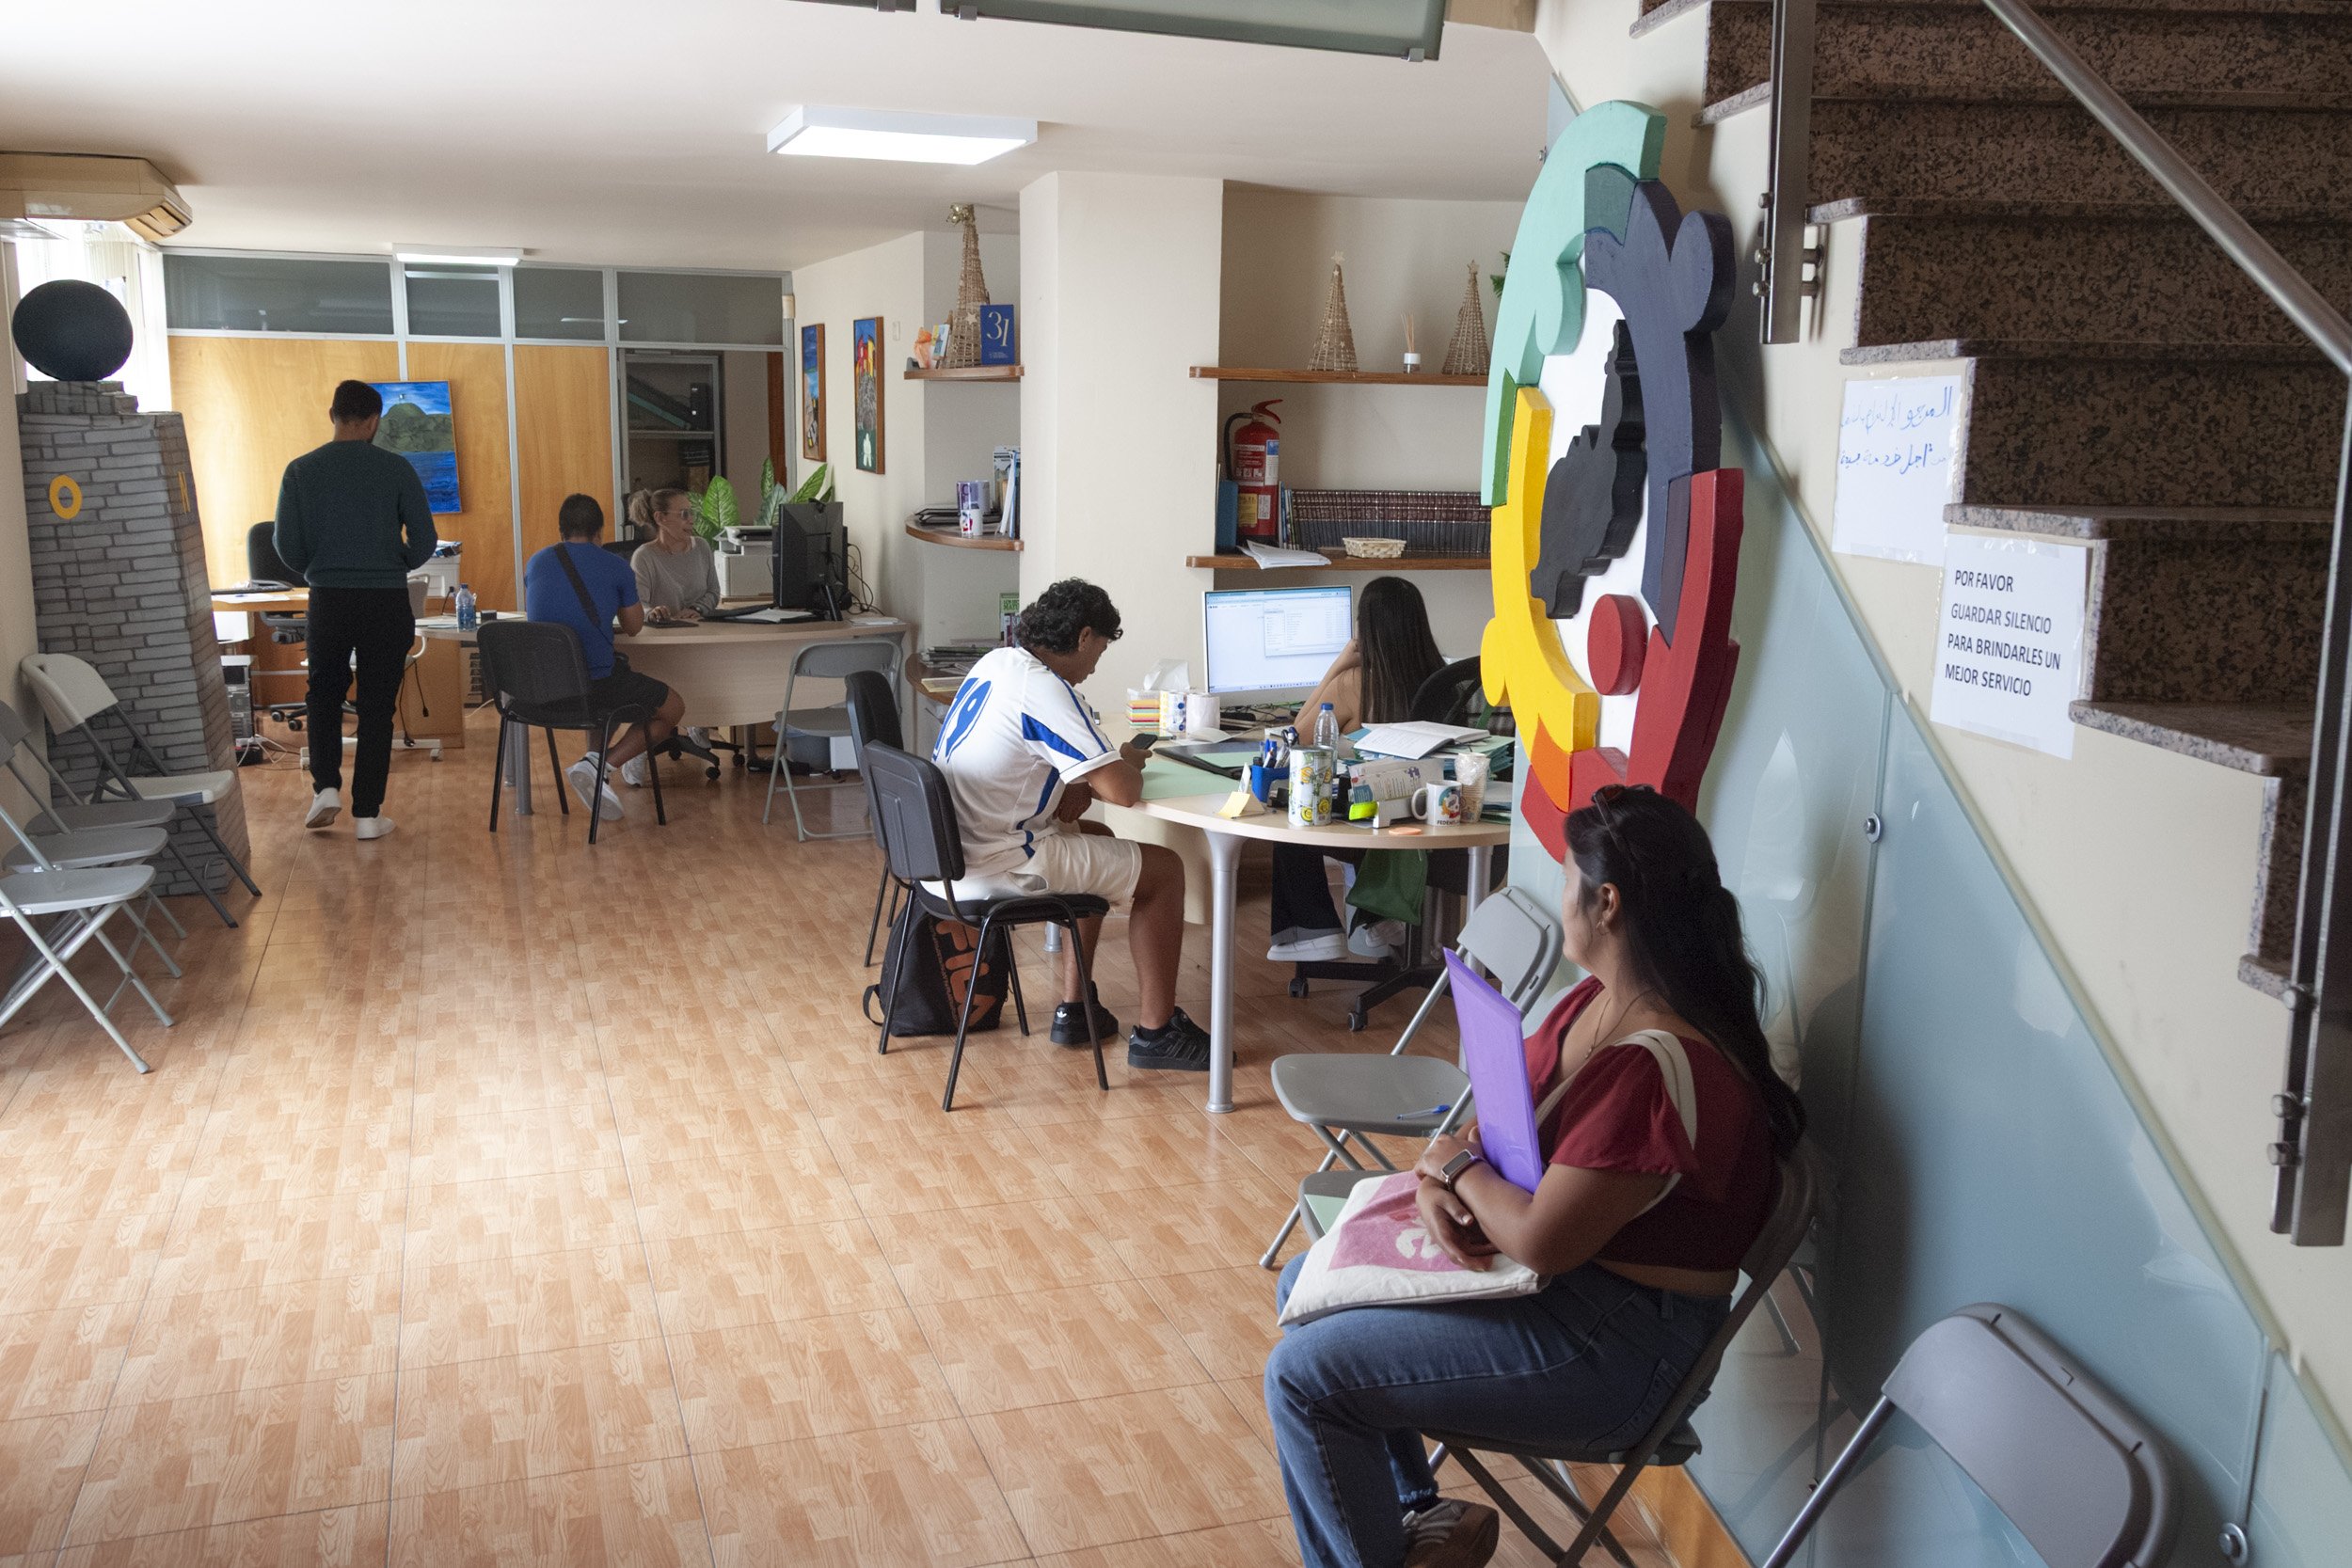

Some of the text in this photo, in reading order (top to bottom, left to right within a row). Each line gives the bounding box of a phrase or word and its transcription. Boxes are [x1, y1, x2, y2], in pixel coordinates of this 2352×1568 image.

[986, 310, 1009, 347] 31
[1954, 570, 2013, 593] POR FAVOR
[1951, 603, 2052, 634] GUARDAR SILENCIO
[1947, 633, 2061, 670] PARA BRINDARLES UN
[1945, 663, 2032, 696] MEJOR SERVICIO
